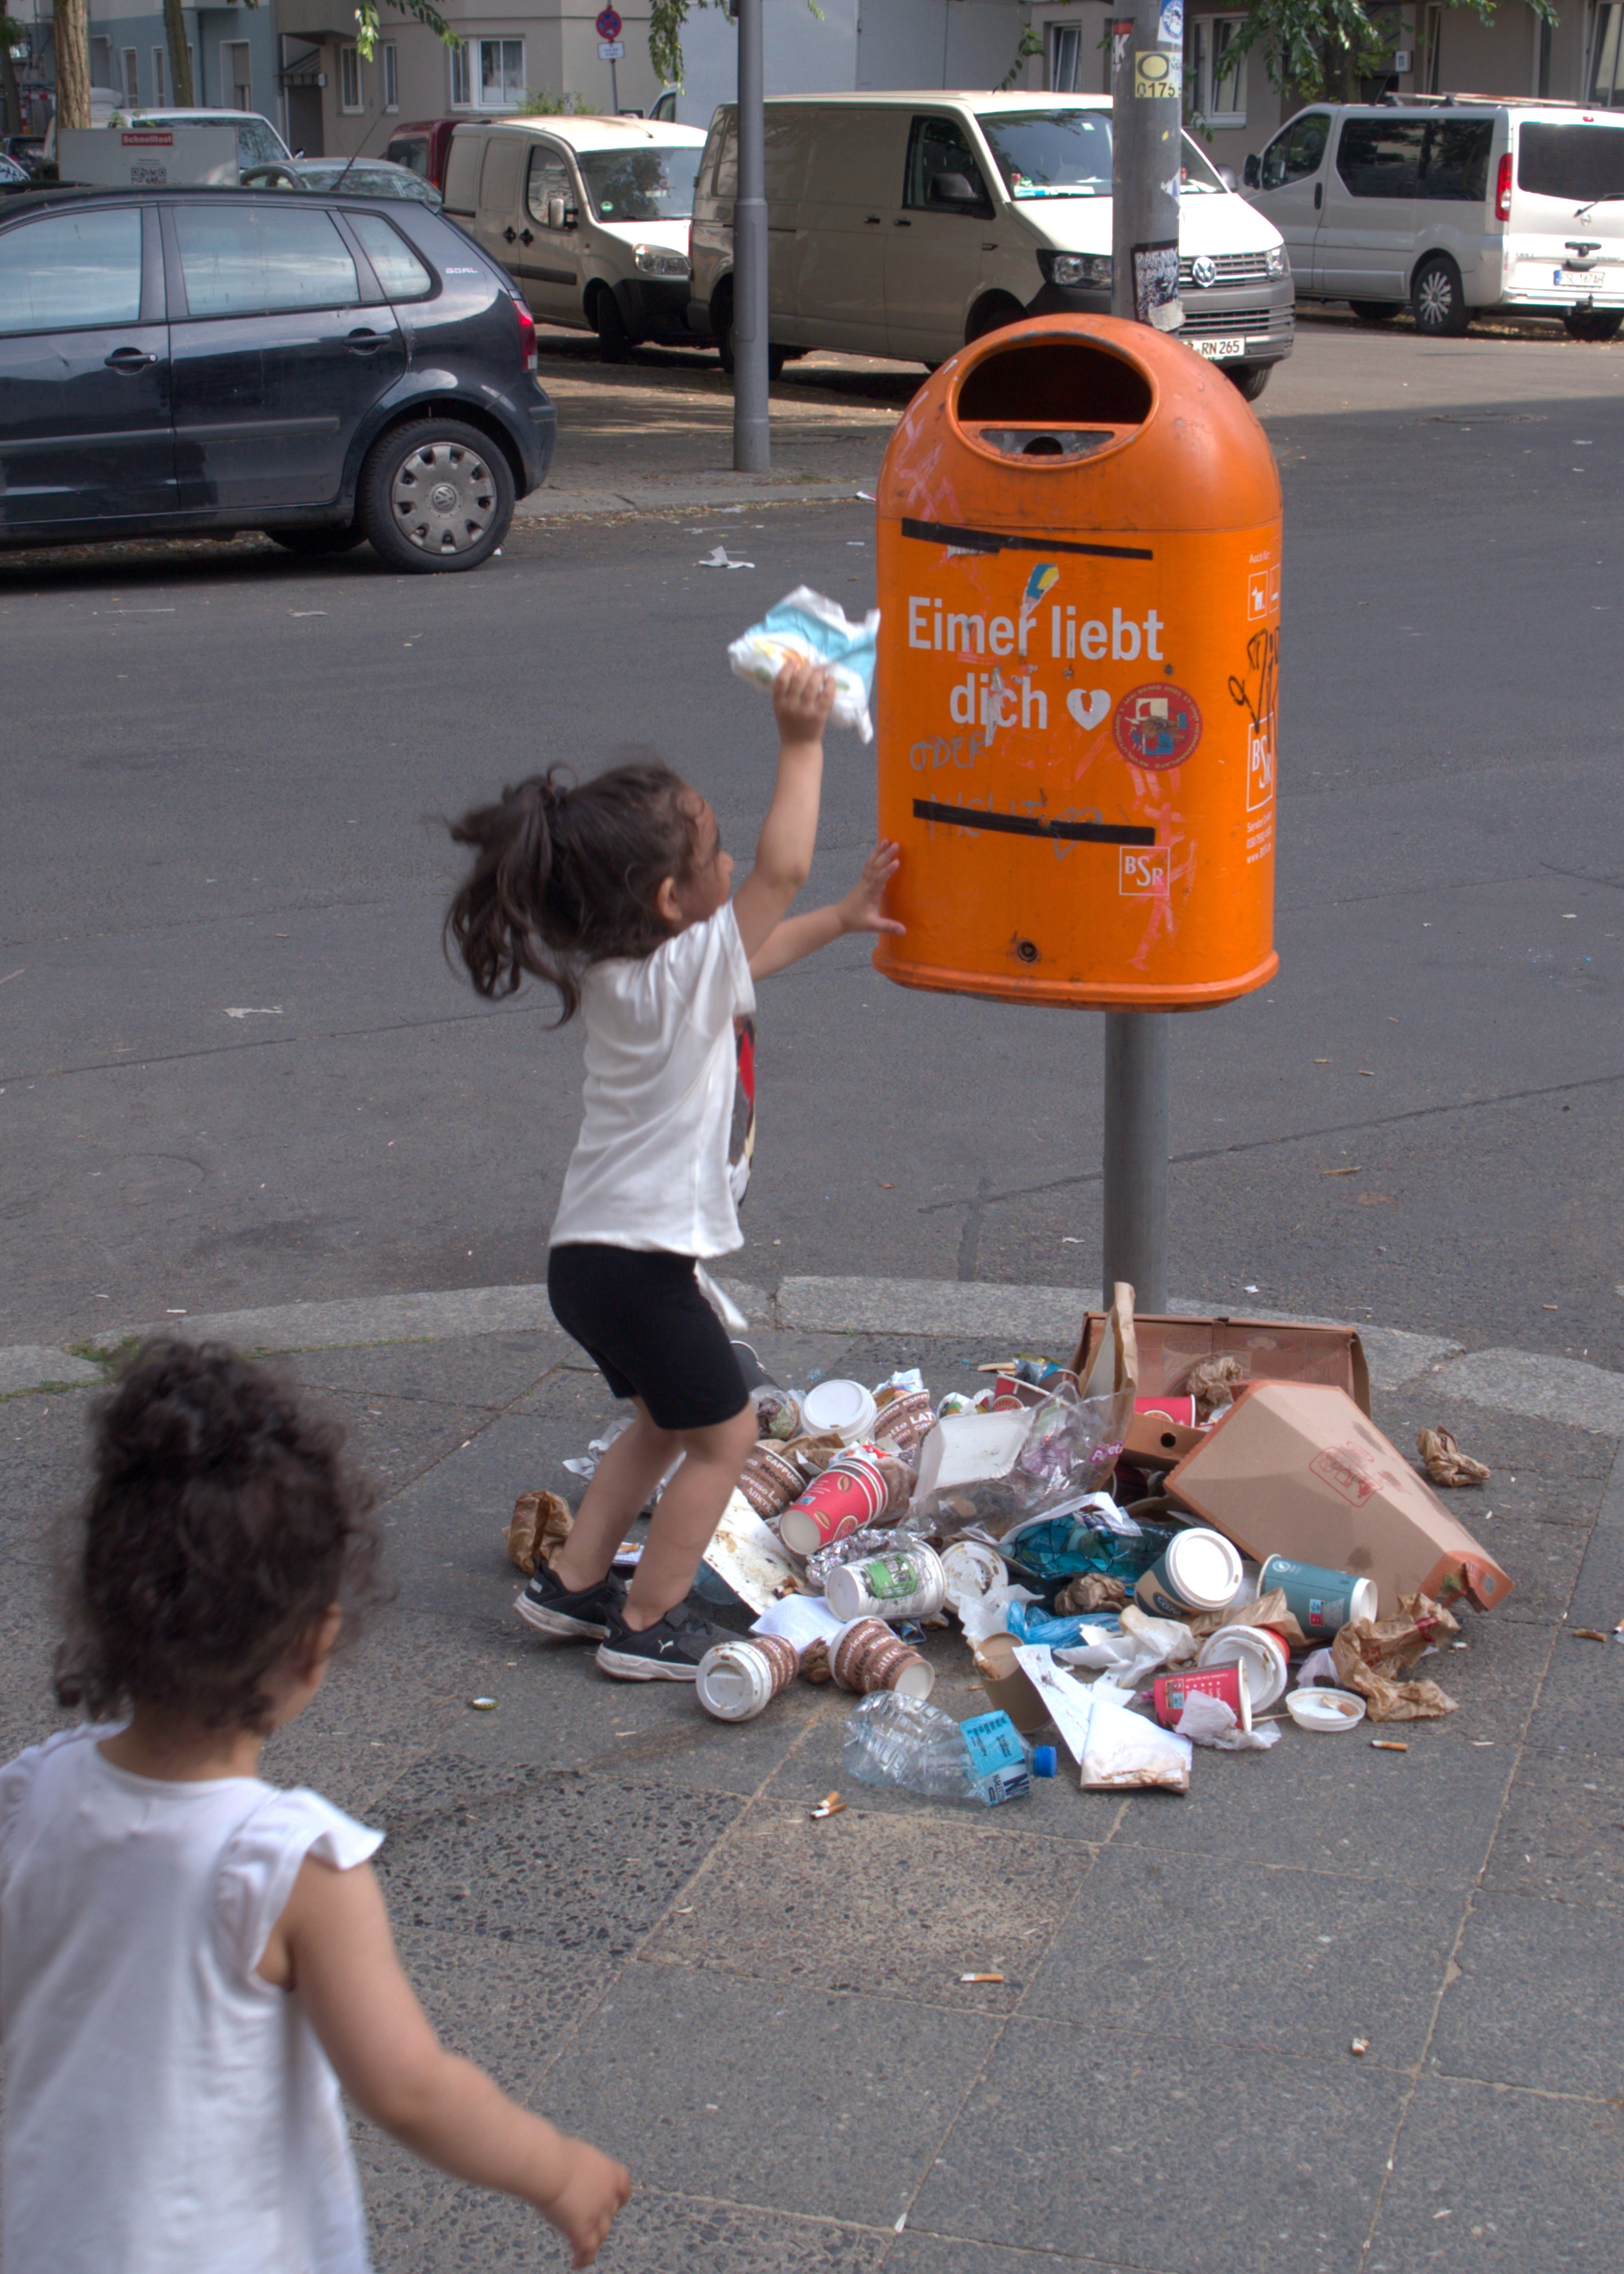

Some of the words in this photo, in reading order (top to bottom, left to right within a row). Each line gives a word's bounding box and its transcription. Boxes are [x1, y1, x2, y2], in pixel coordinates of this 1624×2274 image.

[1201, 342, 1217, 355] RN
[1219, 340, 1240, 354] 265
[909, 596, 1036, 656] Eimer
[1052, 605, 1163, 660] liebt
[949, 672, 1047, 729] dich
[1251, 735, 1271, 788] BSR
[1125, 855, 1164, 887] BSR
[842, 1627, 875, 1676] Americano
